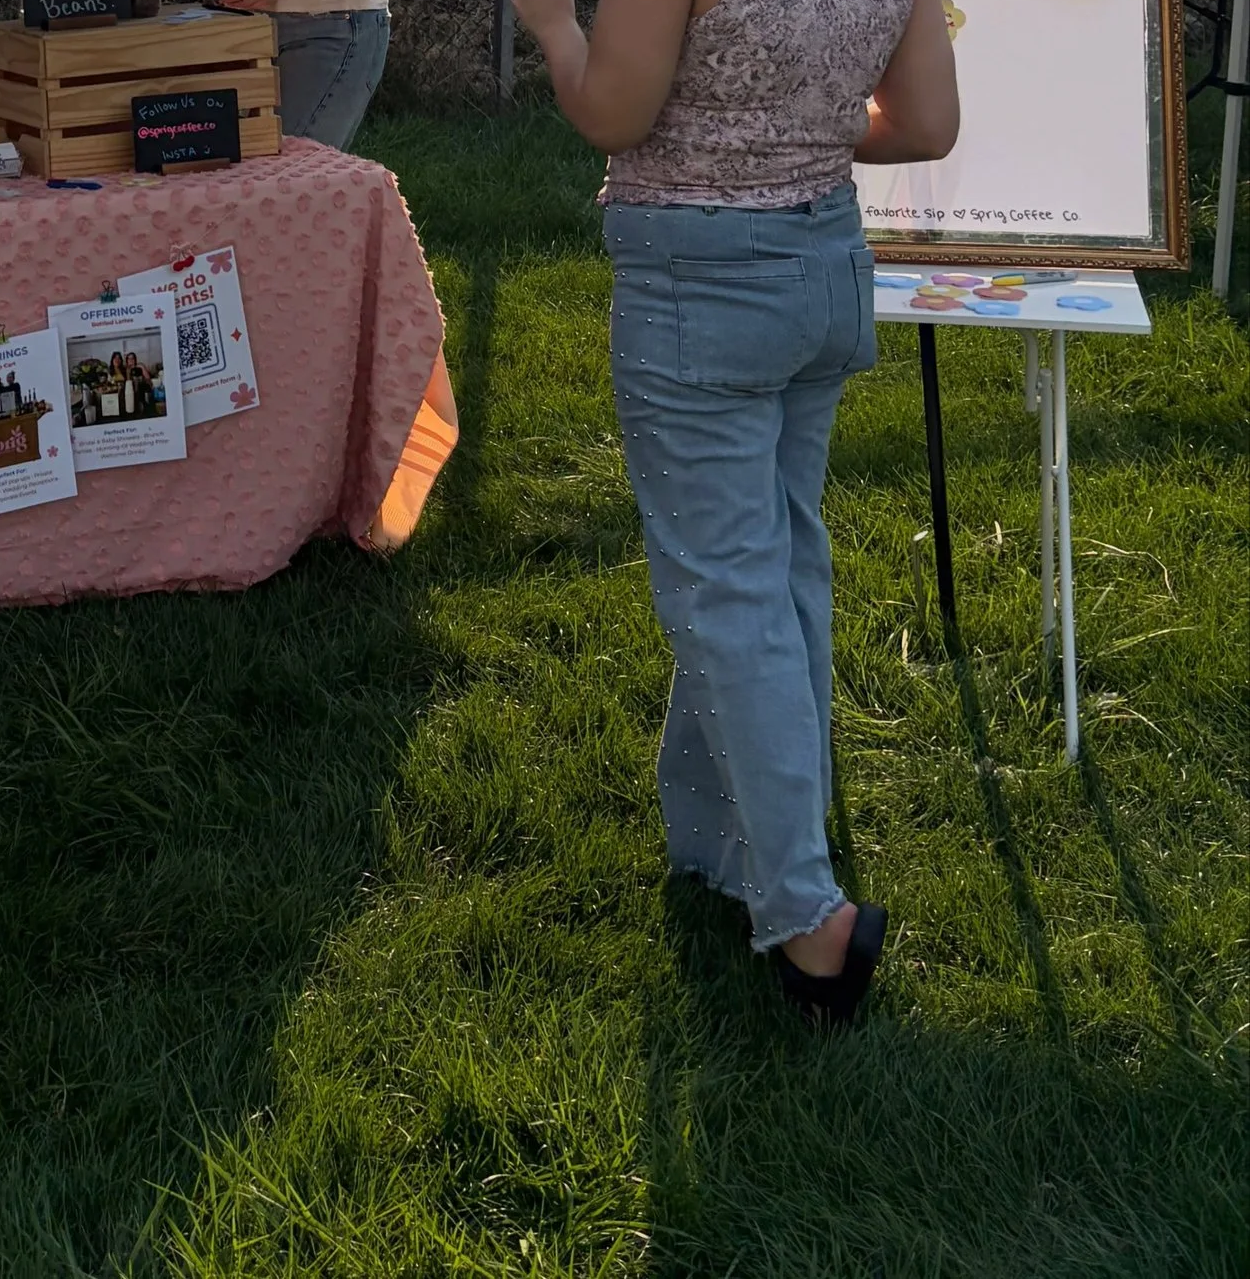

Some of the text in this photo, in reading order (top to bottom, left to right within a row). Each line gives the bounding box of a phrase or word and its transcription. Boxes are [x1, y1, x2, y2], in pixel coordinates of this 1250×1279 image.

[184, 273, 206, 289] do
[175, 285, 214, 309] ents!
[80, 305, 143, 321] OFFERINGS
